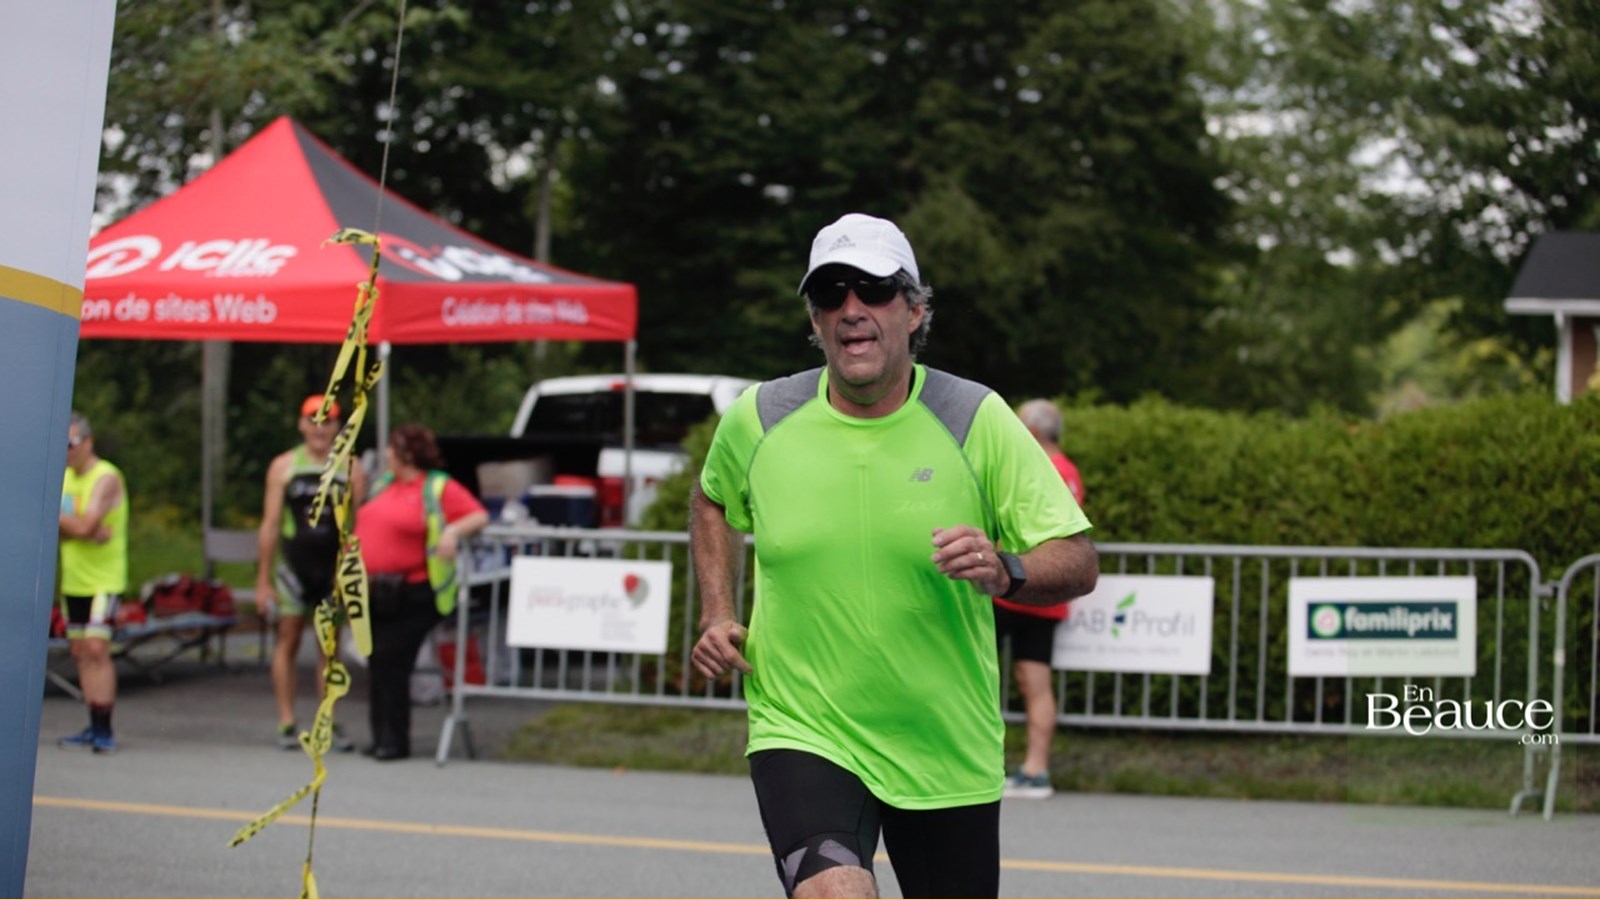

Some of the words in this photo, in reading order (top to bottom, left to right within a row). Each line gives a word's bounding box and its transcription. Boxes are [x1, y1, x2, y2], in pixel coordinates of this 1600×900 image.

[114, 292, 150, 321] de
[153, 293, 212, 323] sites
[213, 293, 278, 324] Web
[1132, 610, 1196, 637] Profil
[1344, 606, 1453, 637] familiprix
